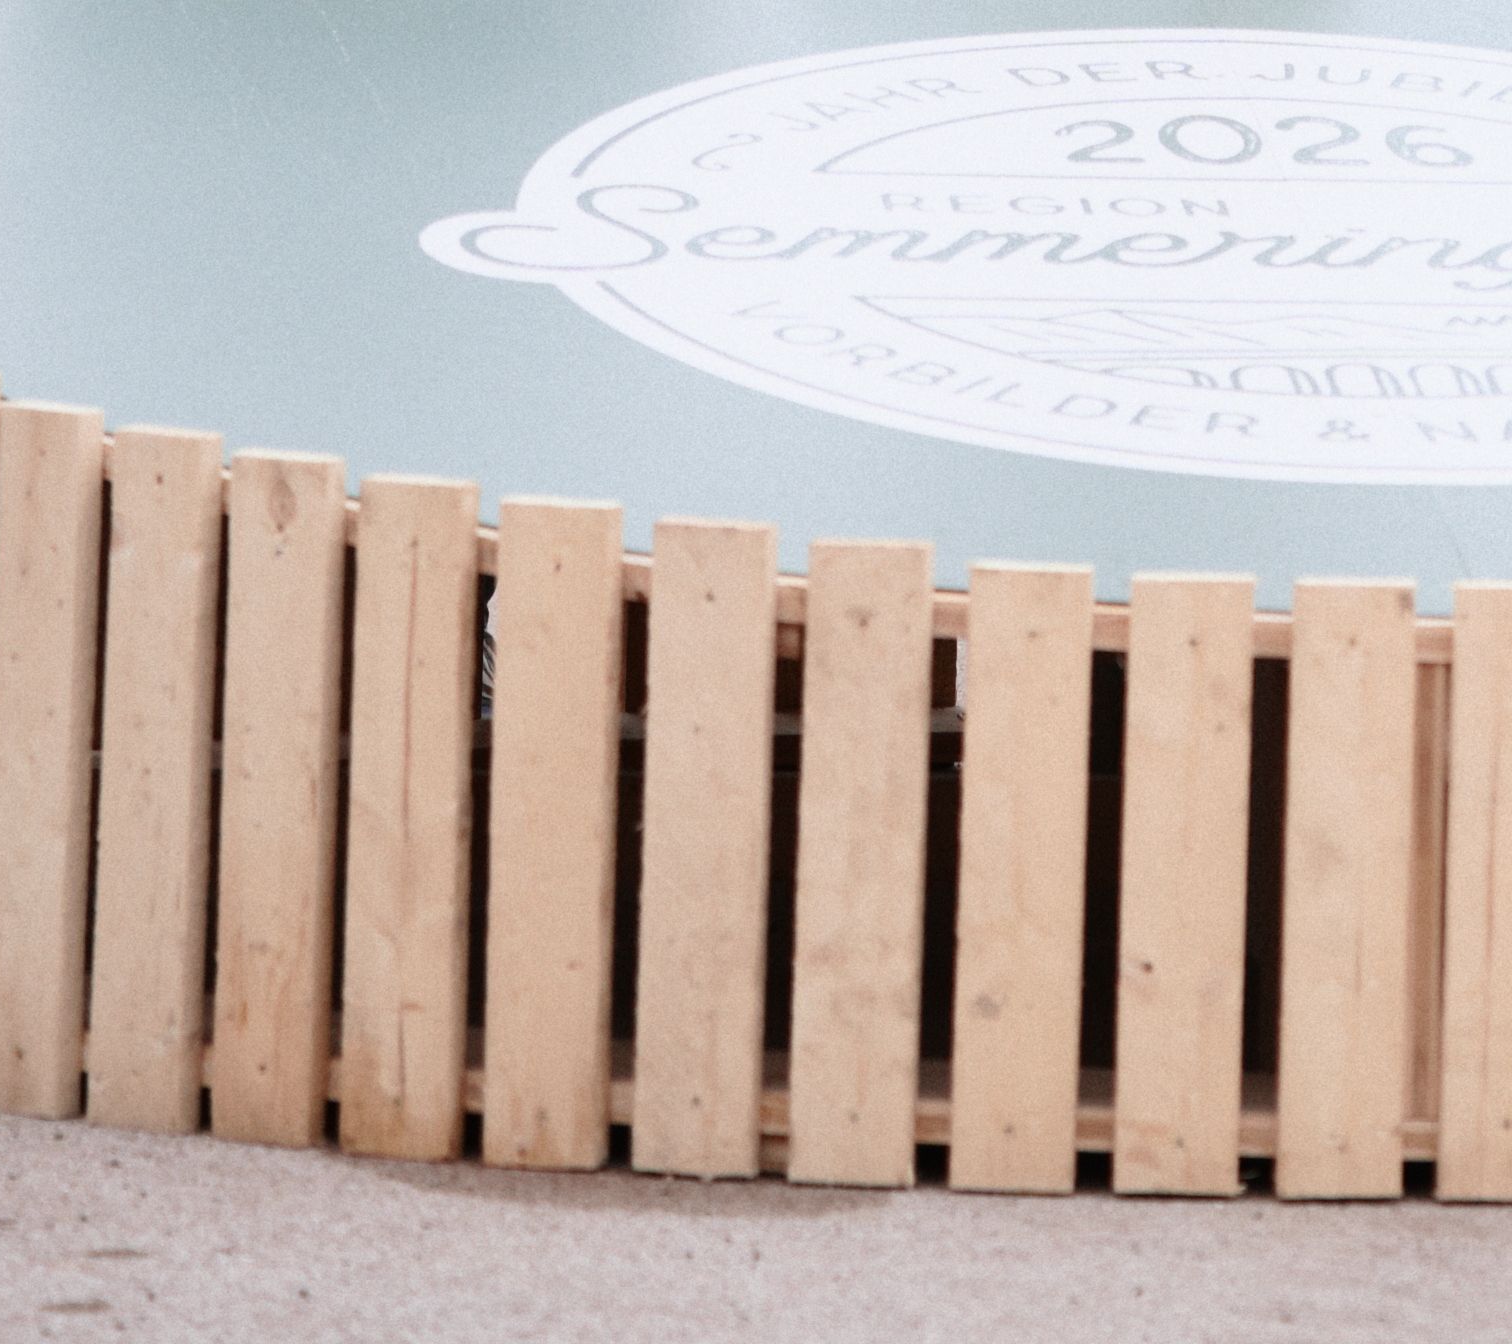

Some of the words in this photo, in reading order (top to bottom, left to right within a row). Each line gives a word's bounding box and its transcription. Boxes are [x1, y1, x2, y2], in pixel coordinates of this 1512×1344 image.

[771, 76, 983, 133] JAHR
[1007, 60, 1211, 88] DER
[1054, 113, 1475, 169] 2026
[881, 191, 1231, 219] REGION
[734, 298, 1263, 439] VORBILDER
[1316, 418, 1371, 444] &
